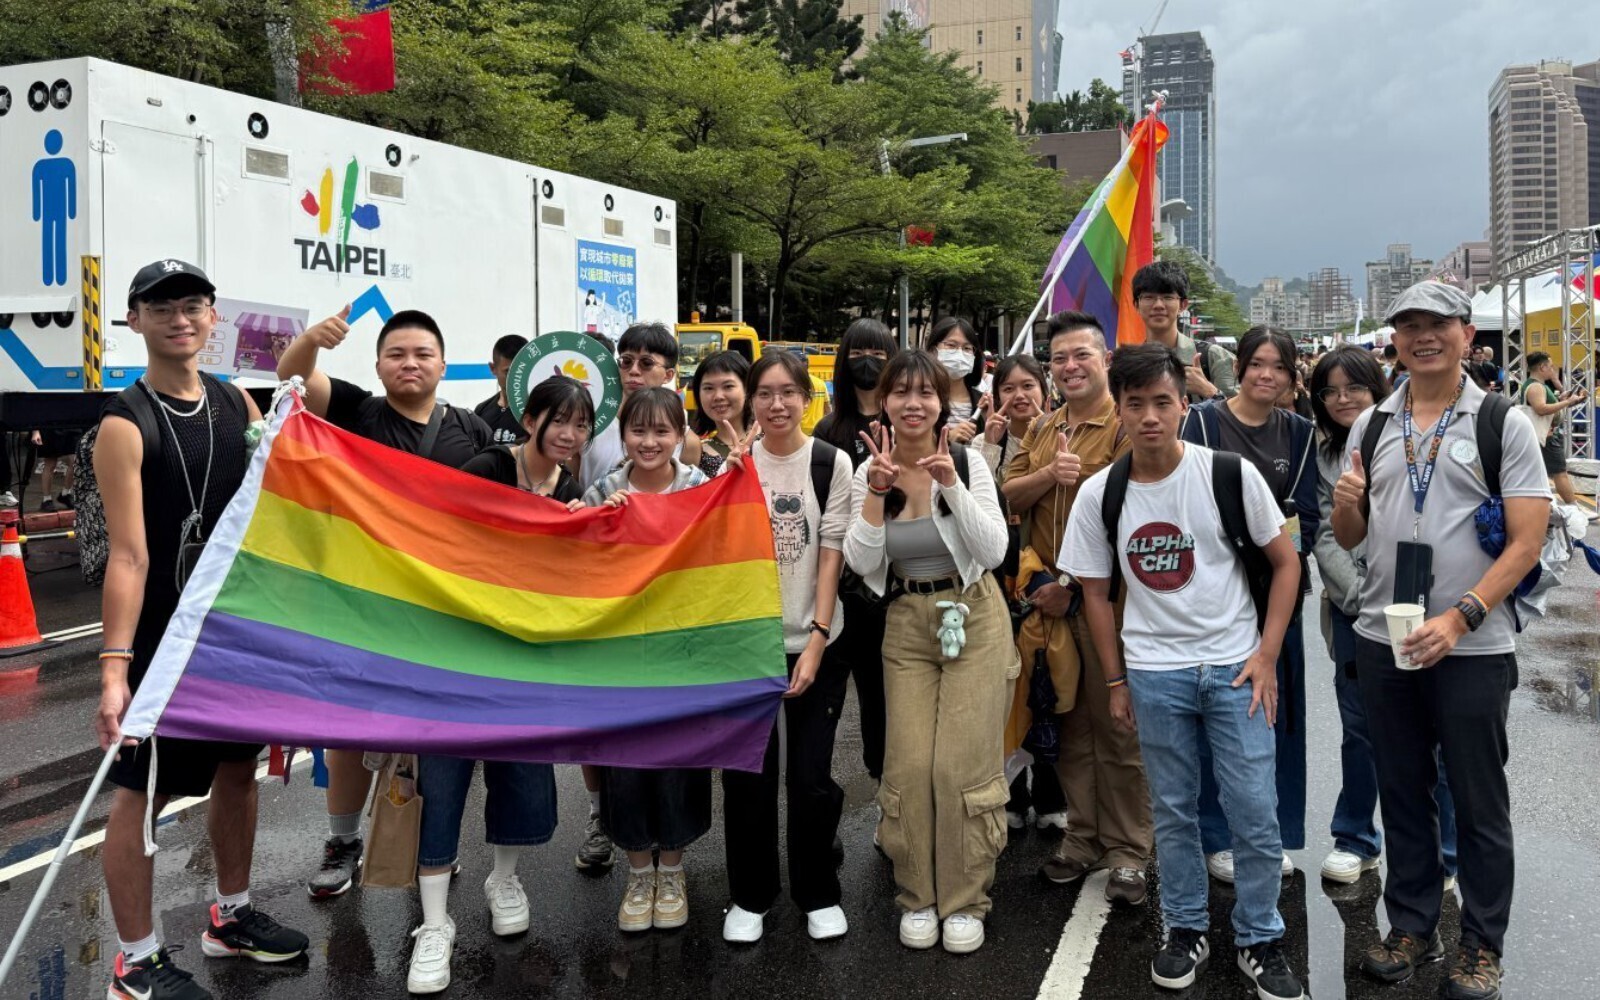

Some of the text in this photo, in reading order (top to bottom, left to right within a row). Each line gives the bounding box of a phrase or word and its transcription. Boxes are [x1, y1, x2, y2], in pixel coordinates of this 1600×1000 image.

[162, 260, 184, 272] LA
[294, 238, 385, 276] TAIPEI
[390, 263, 410, 279] 臺北
[512, 361, 526, 407] NATIONAL
[777, 543, 800, 552] LITTLE
[1126, 533, 1194, 555] ALPHA
